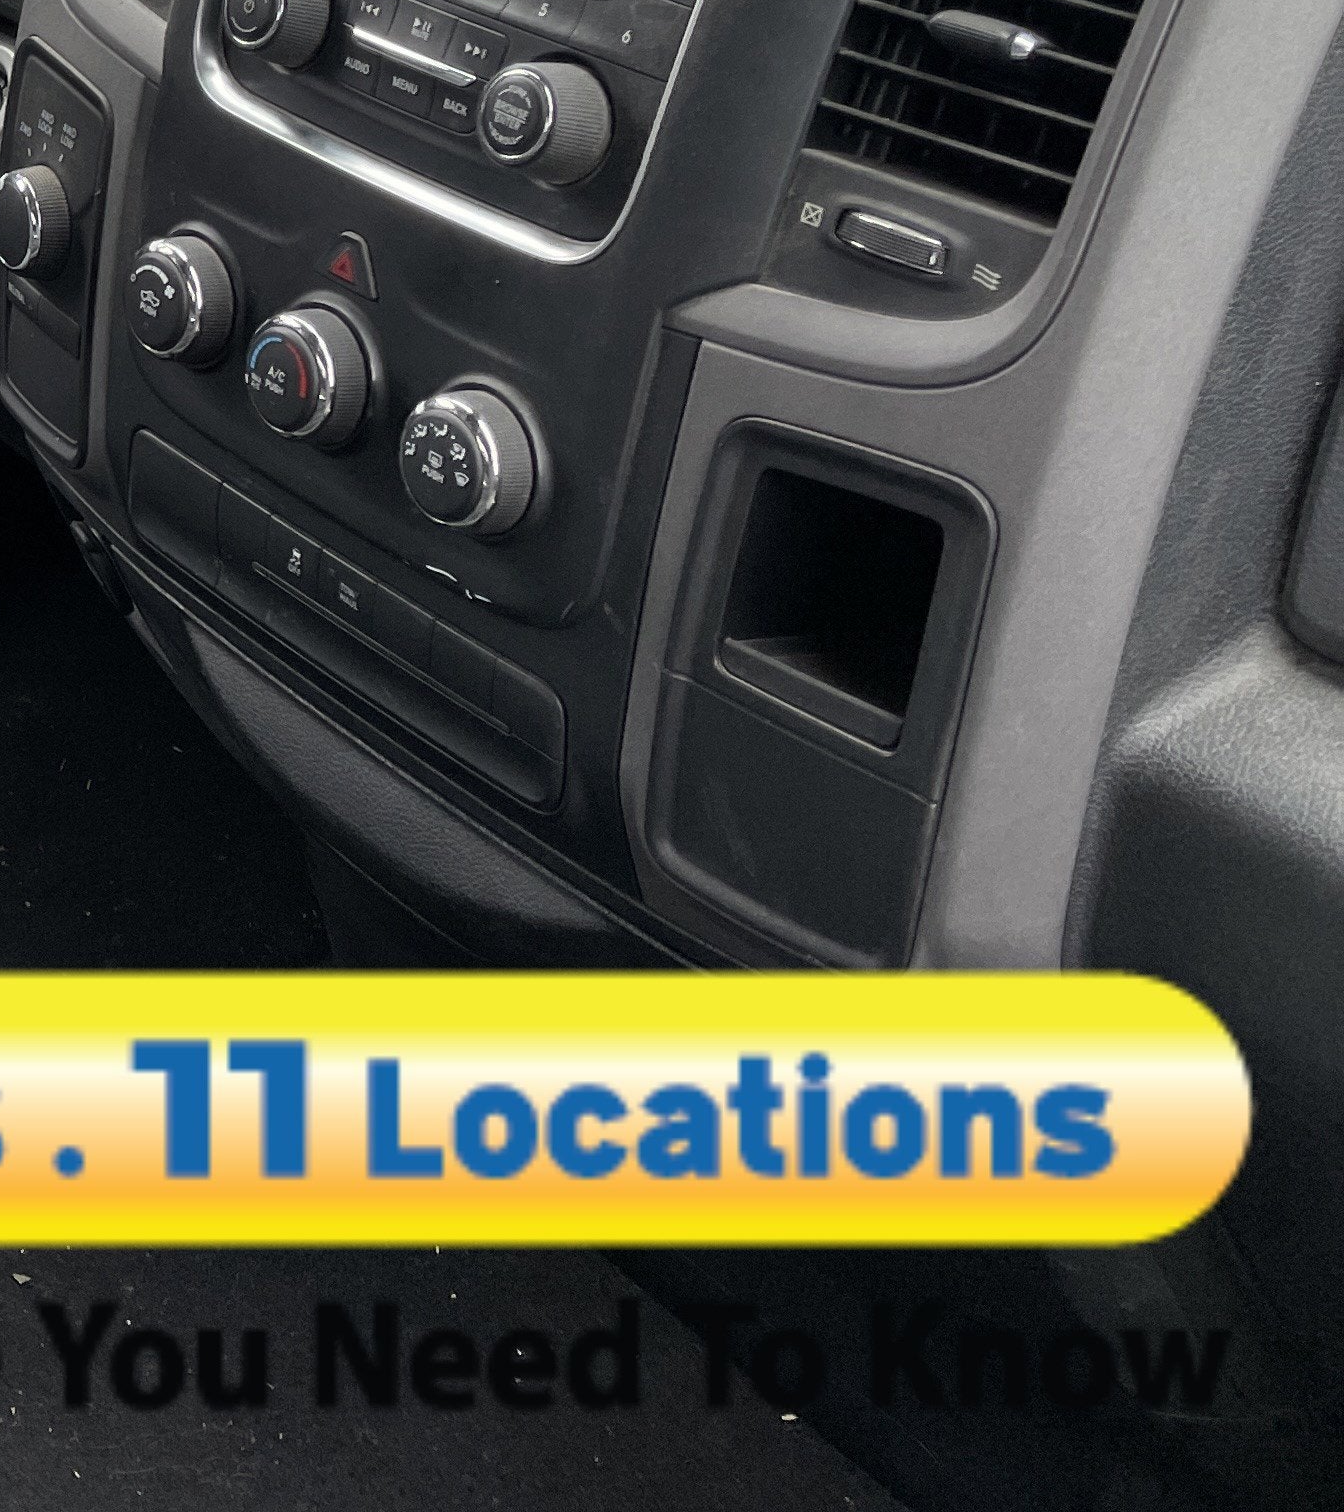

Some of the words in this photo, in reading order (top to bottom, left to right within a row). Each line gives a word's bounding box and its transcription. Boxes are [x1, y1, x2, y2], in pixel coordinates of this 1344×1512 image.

[538, 2, 551, 18] 5
[620, 29, 633, 45] 6
[344, 56, 370, 75] AUDIO
[392, 75, 419, 95] MENU
[442, 97, 468, 117] BACK
[267, 365, 287, 384] A/C
